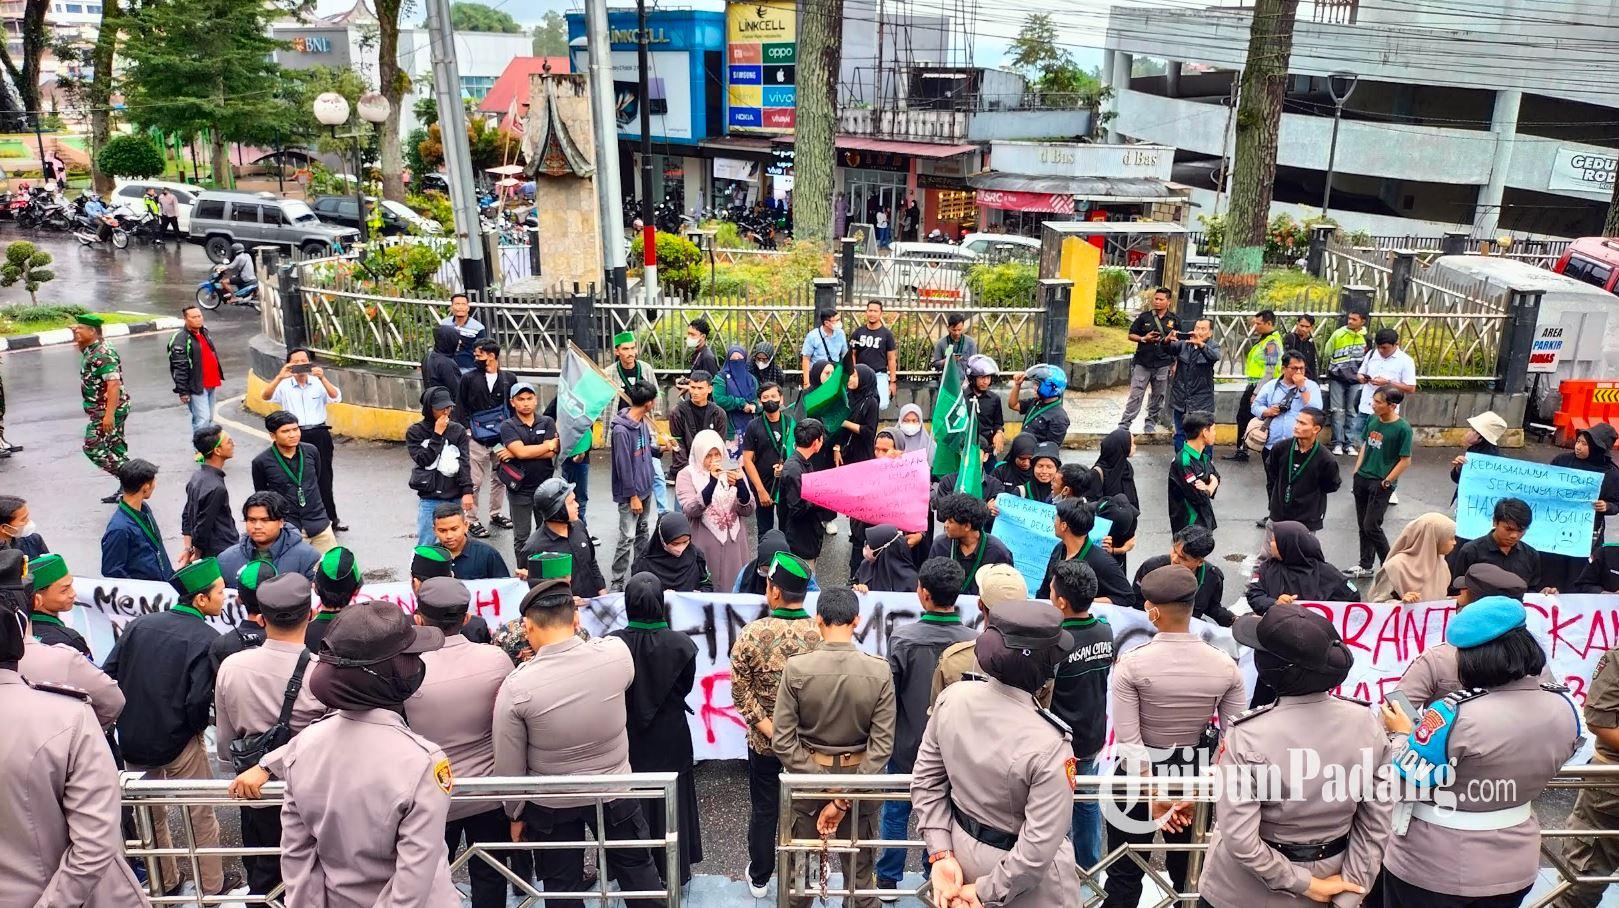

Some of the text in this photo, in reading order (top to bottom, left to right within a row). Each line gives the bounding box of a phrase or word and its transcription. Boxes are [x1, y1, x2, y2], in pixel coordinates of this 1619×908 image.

[305, 37, 327, 52] BNI
[768, 47, 793, 59] oppo
[768, 91, 795, 103] vivo
[735, 113, 755, 121] NOKIA
[1052, 149, 1075, 165] Bas
[1122, 151, 1157, 167] d Bas
[983, 191, 1004, 203] SRC
[1541, 328, 1563, 338] AREA
[1532, 340, 1563, 350] PARKIR
[1529, 353, 1556, 364] DINAS
